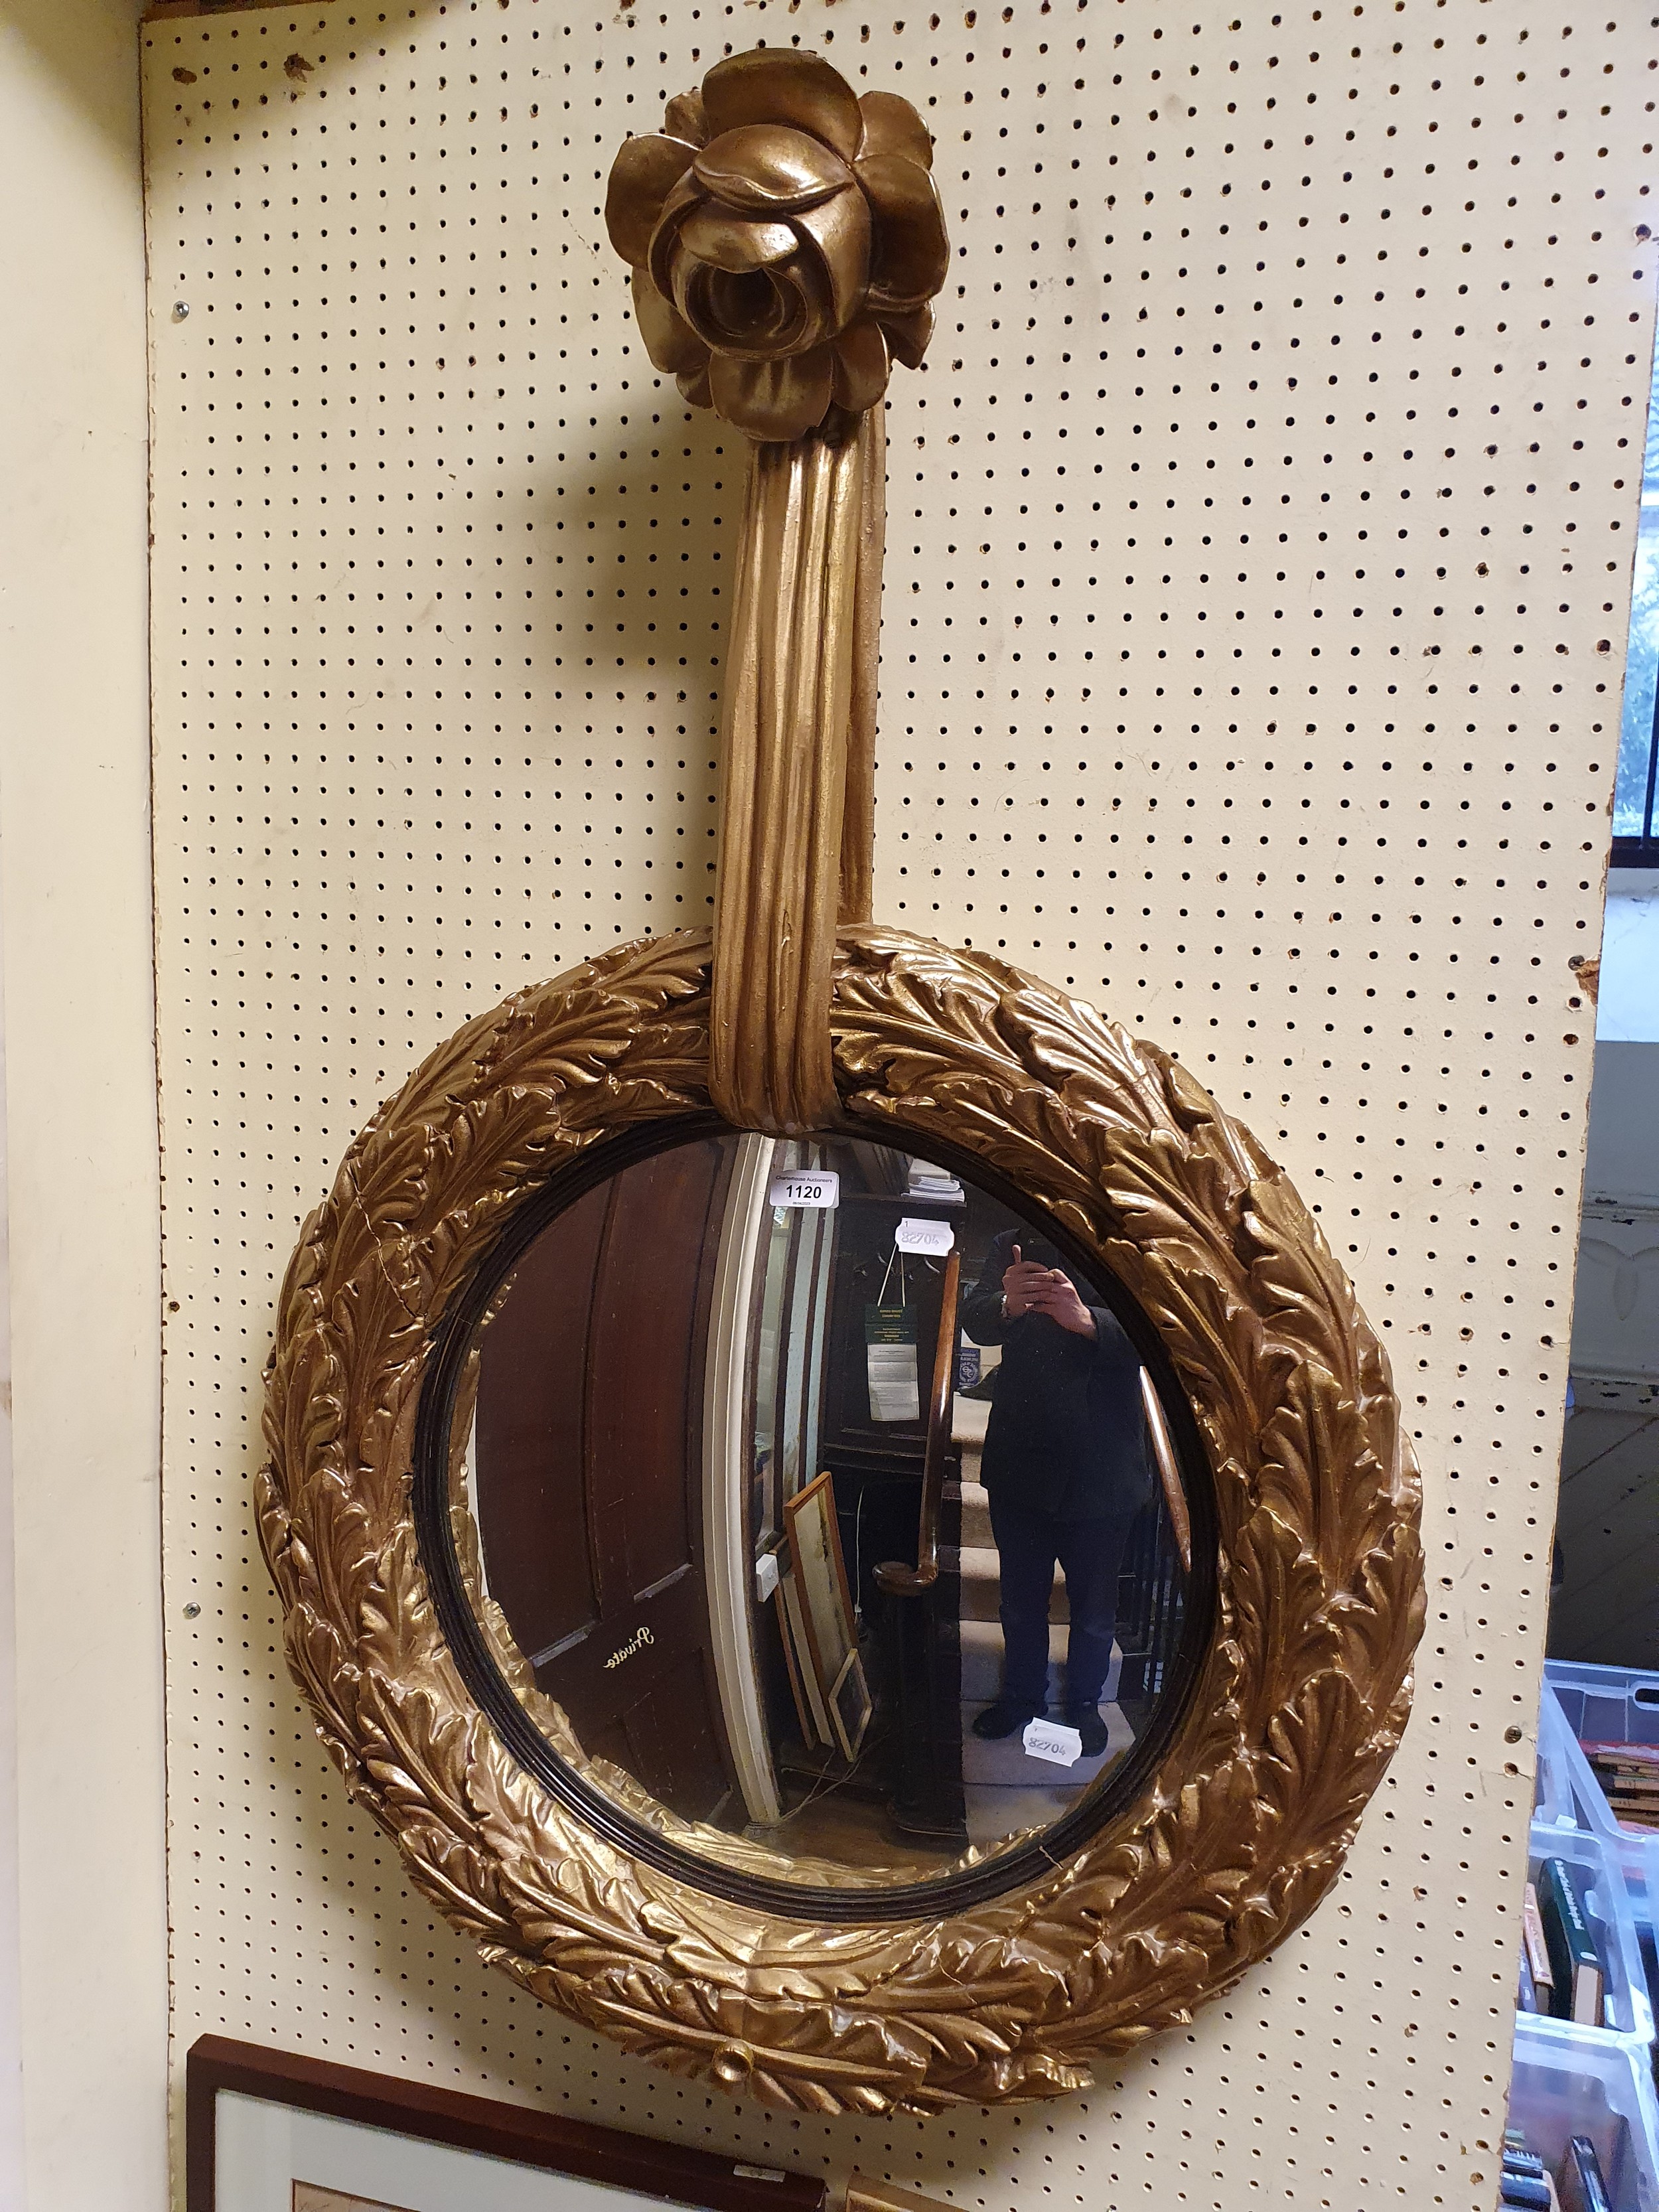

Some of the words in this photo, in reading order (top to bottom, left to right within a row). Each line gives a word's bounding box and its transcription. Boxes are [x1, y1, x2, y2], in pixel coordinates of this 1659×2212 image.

[786, 1184, 822, 1199] 1120
[901, 1232, 940, 1246] 82704
[1028, 1737, 1066, 1756] 82704
